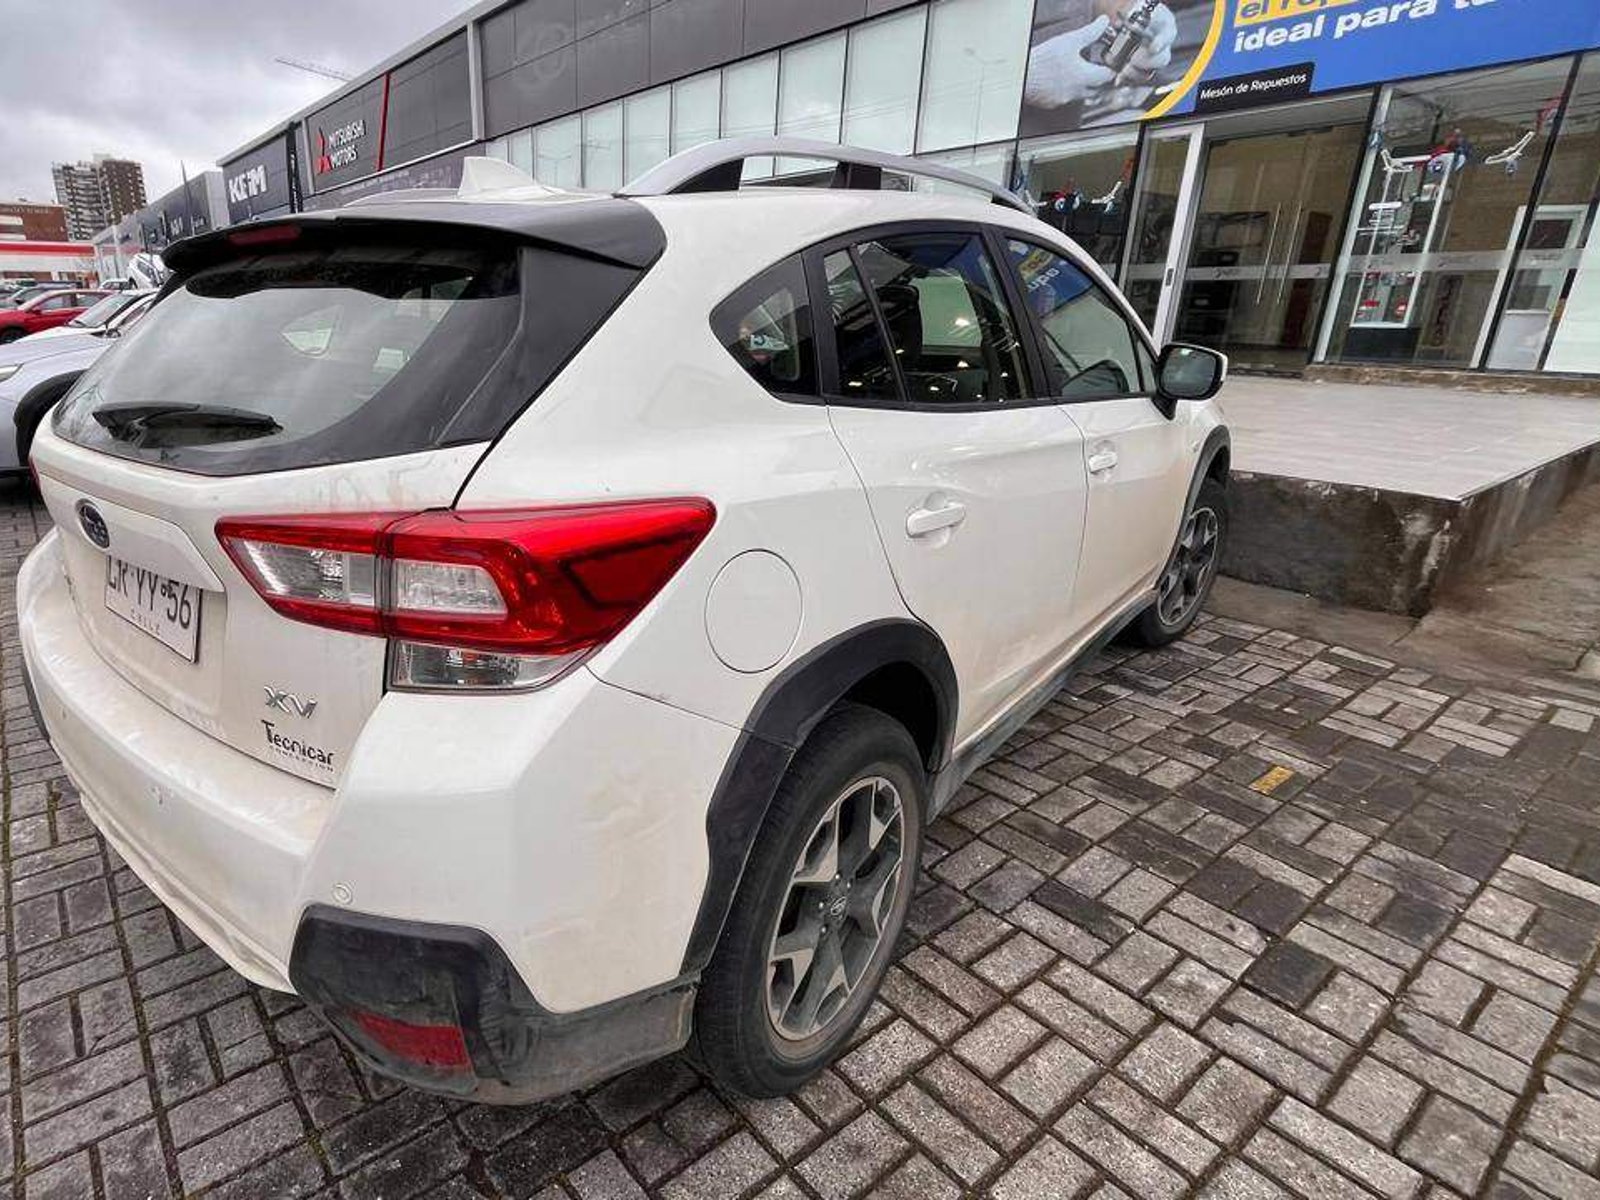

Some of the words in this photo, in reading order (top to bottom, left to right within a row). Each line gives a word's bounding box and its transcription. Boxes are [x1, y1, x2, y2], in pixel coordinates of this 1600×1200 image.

[1233, 14, 1325, 53] ideal
[1333, 0, 1438, 39] para
[1200, 84, 1234, 100] Mesón
[1236, 82, 1249, 94] de
[1250, 72, 1307, 92] Repuestos
[330, 144, 358, 169] MOTORS
[263, 685, 319, 719] XV
[261, 718, 335, 766] Tecnicar
